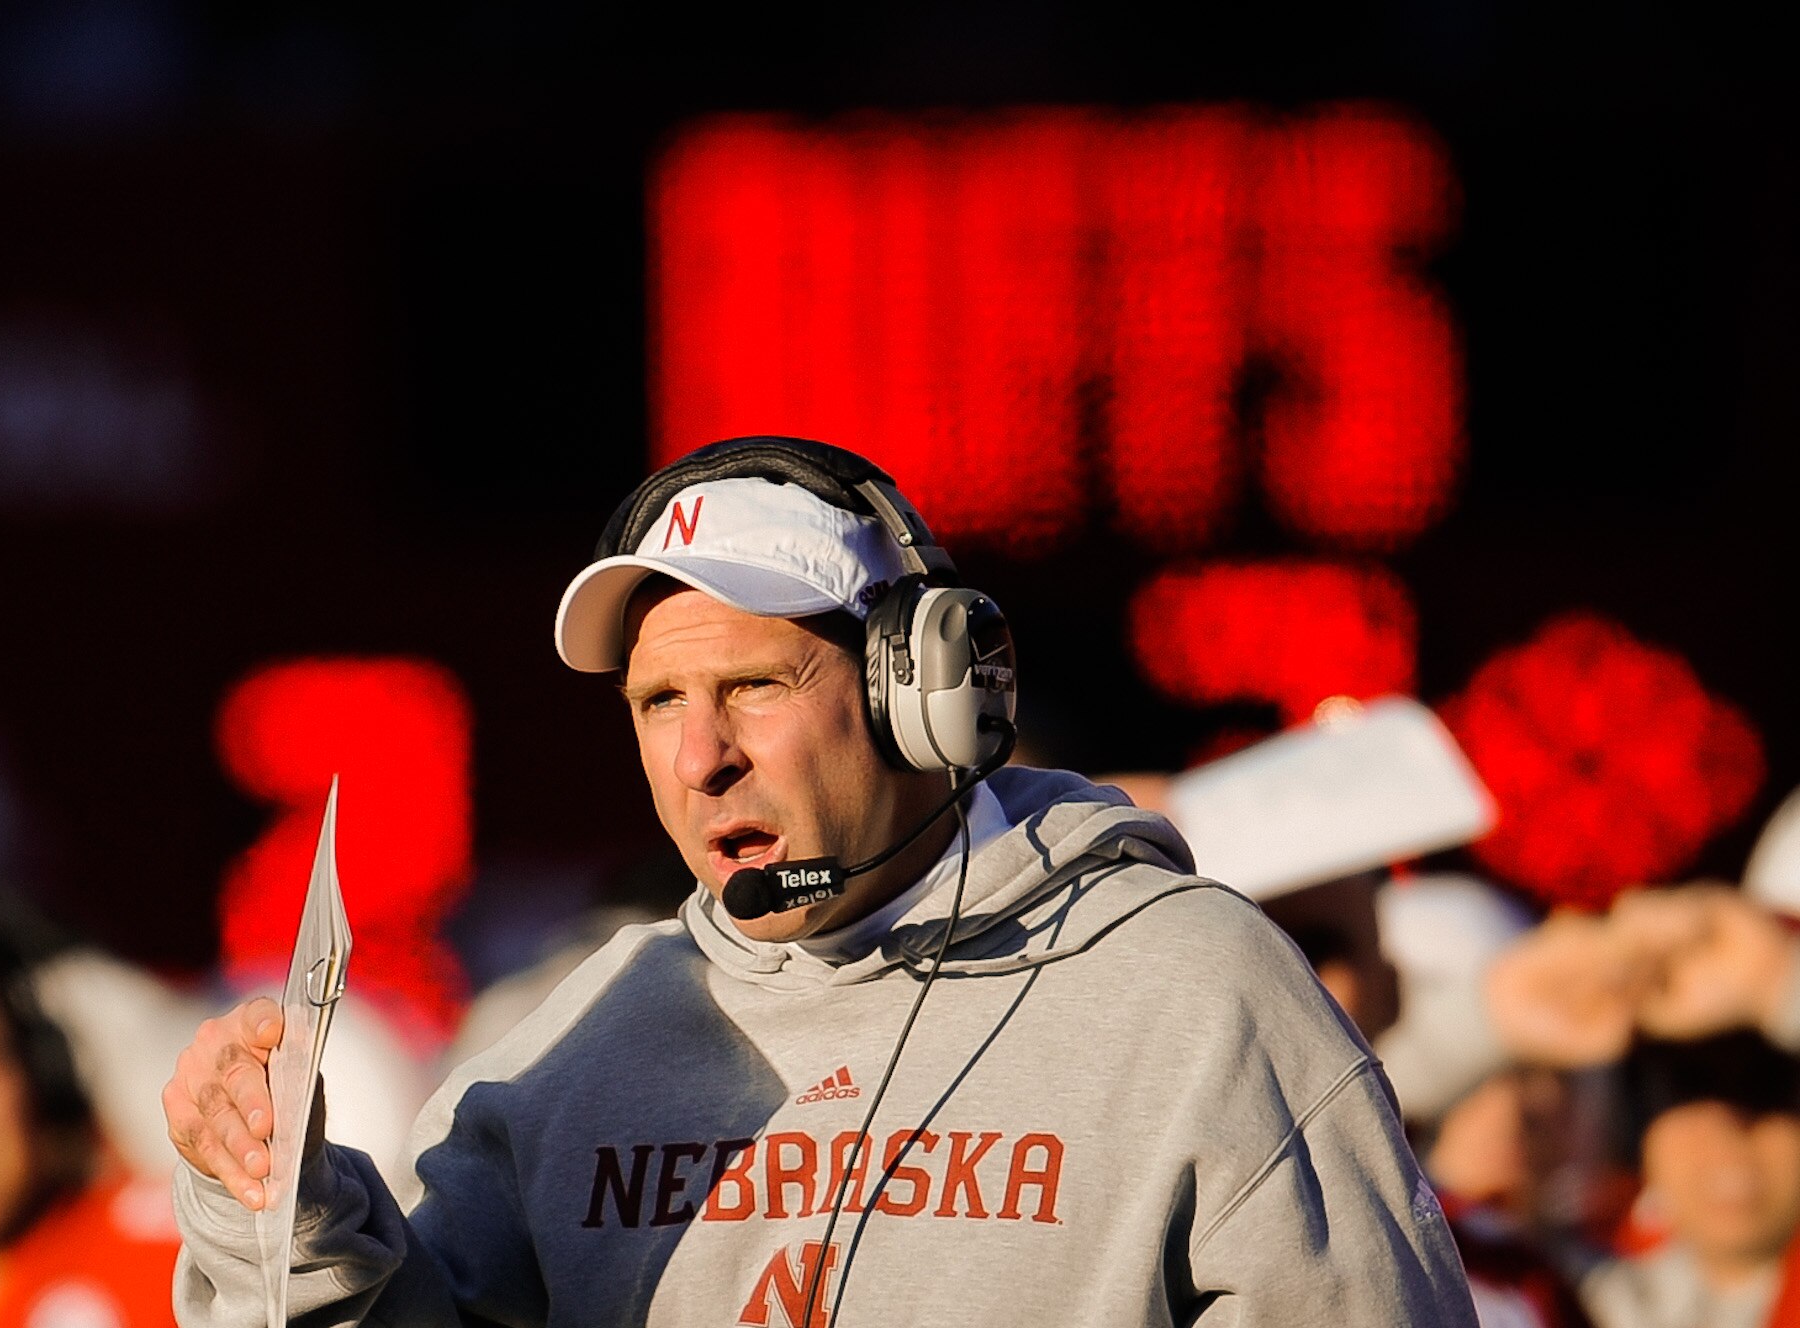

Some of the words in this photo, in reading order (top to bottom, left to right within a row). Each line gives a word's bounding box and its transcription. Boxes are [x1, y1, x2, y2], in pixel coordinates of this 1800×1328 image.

[662, 495, 704, 551] N
[776, 868, 832, 889] Telex
[795, 1086, 861, 1106] adidas
[581, 1127, 1064, 1229] NEBRASKA
